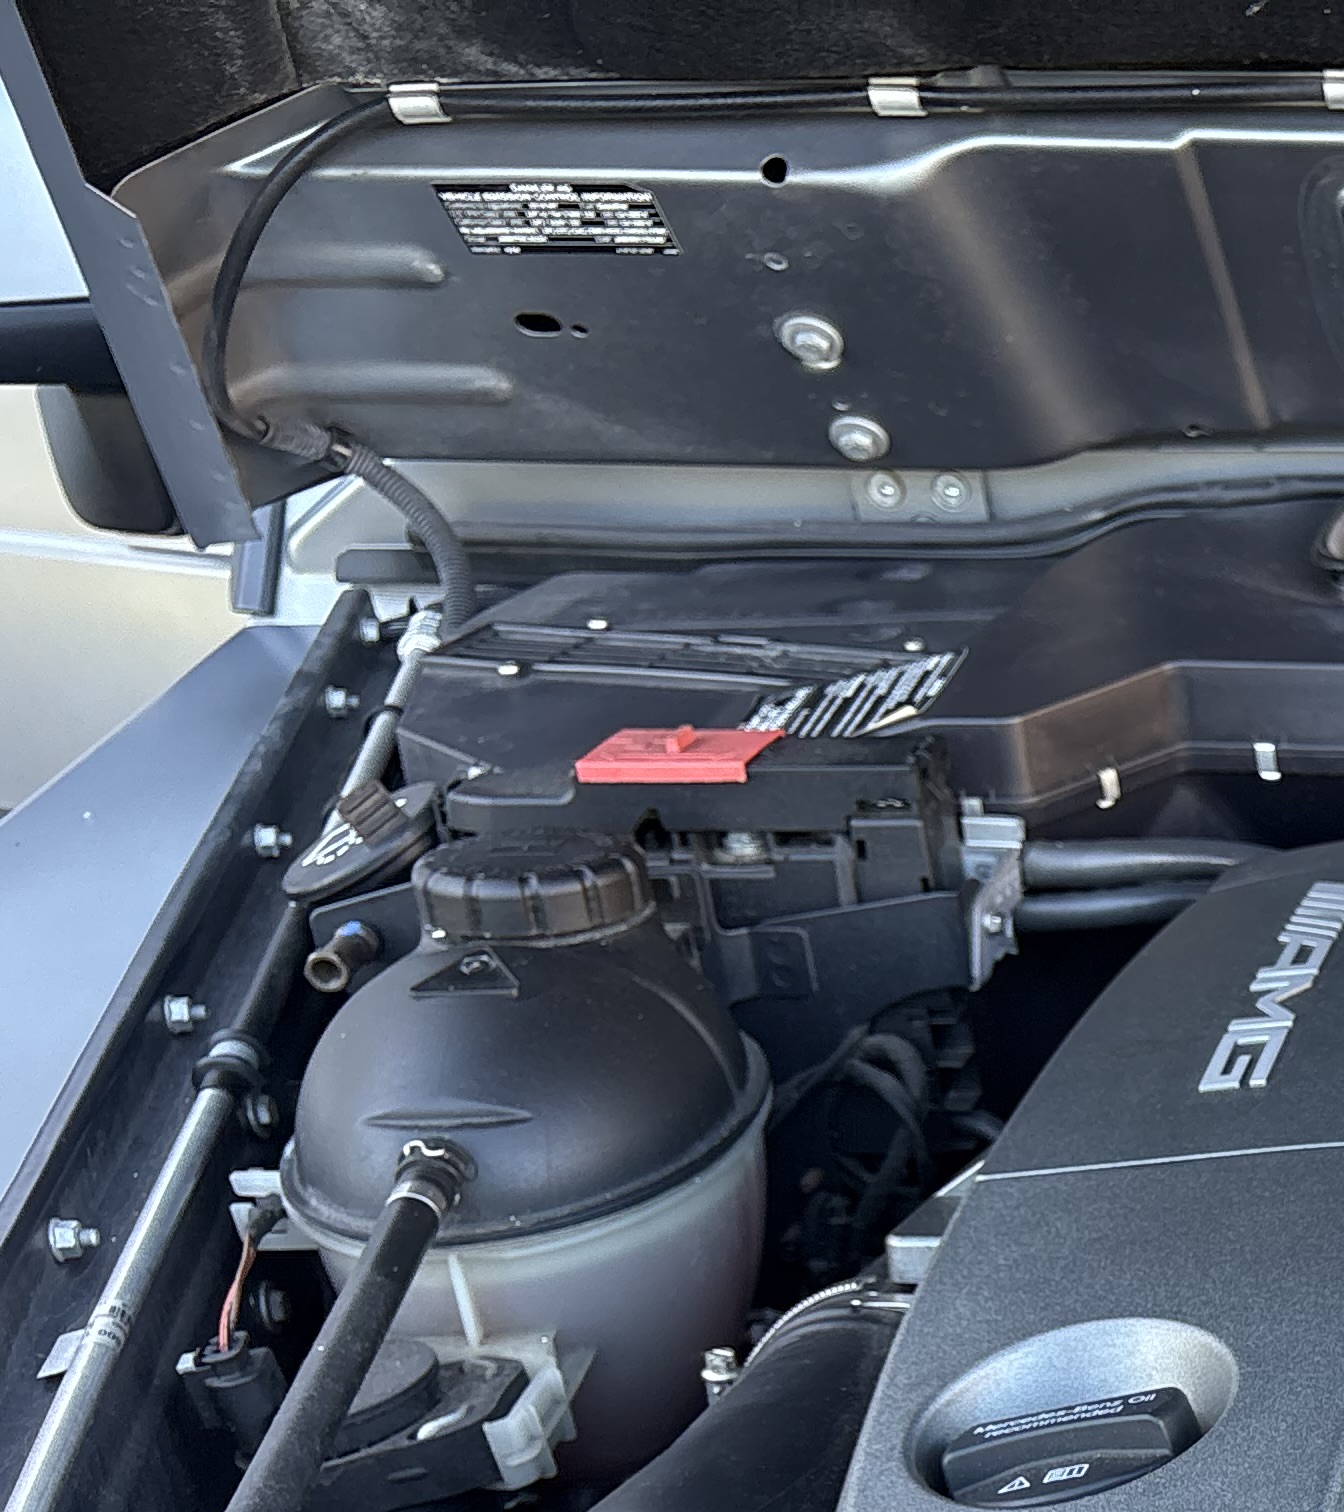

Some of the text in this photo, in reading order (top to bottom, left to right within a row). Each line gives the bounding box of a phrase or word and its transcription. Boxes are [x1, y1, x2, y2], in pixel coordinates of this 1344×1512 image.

[973, 1393, 1157, 1435] Mercedes-Benz Oil
[984, 1405, 1124, 1439] recommended
